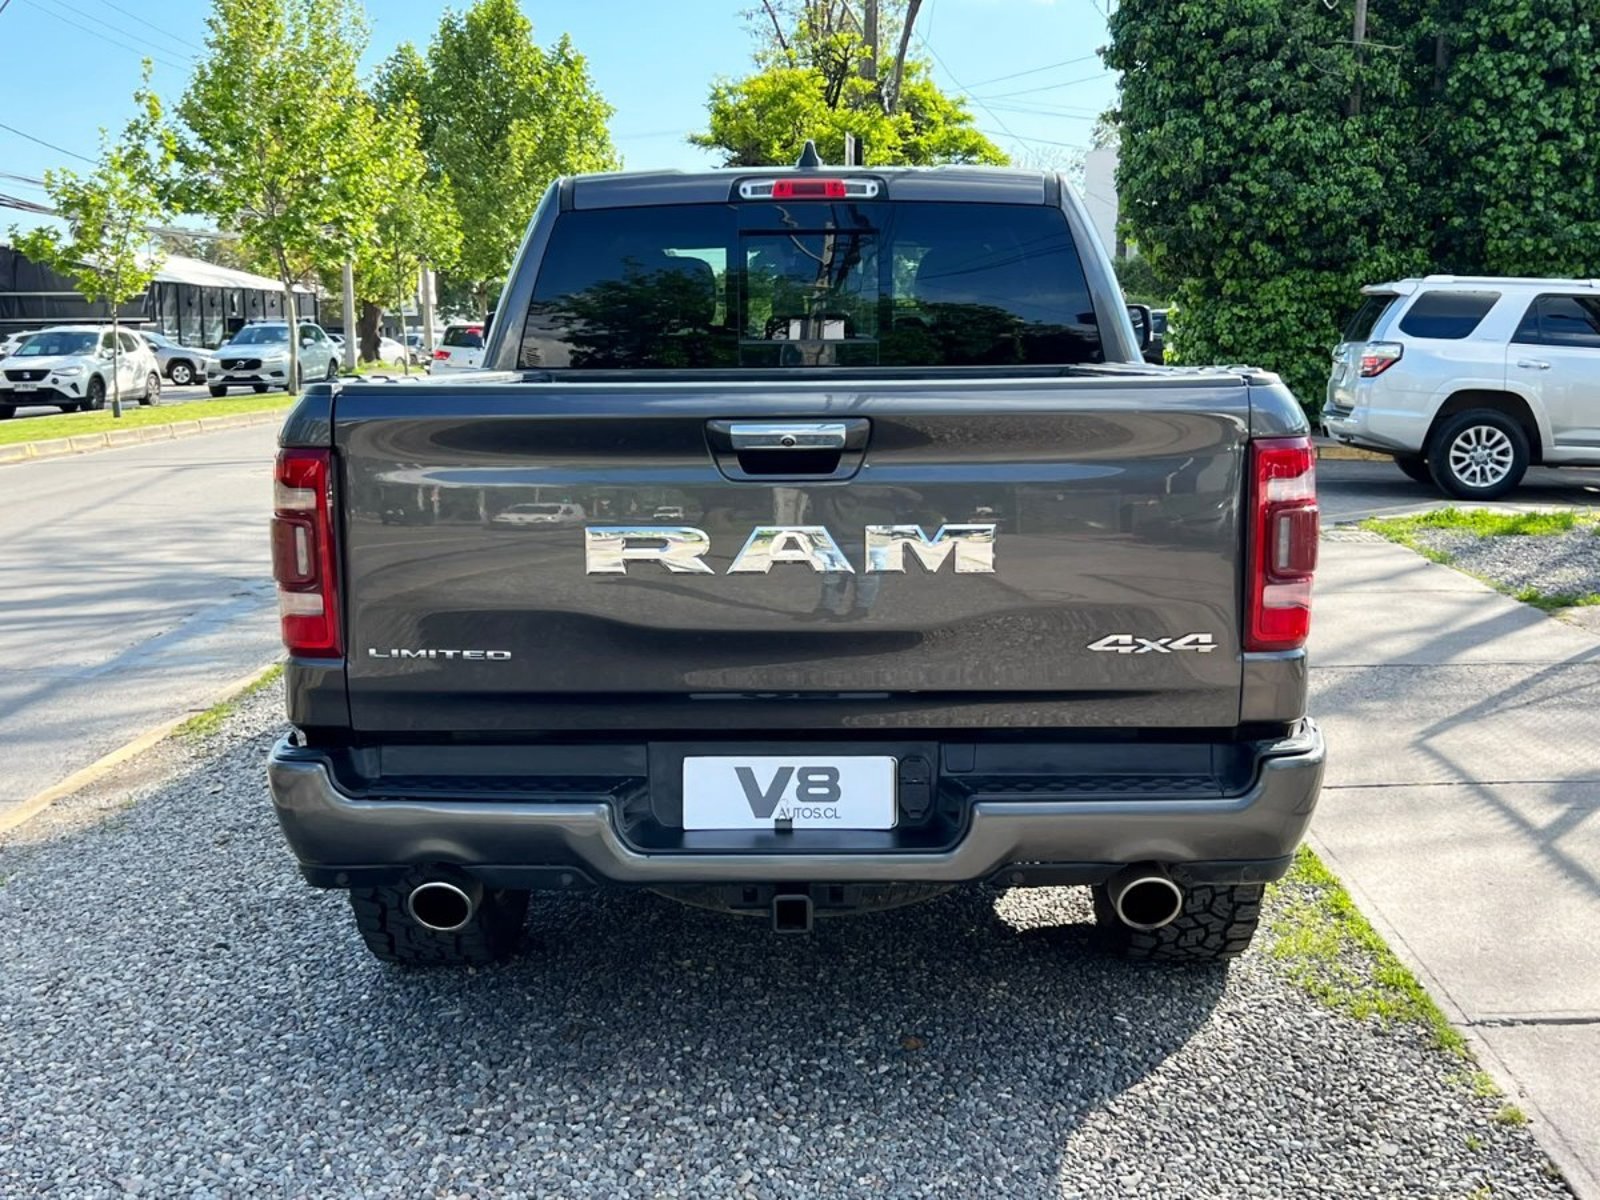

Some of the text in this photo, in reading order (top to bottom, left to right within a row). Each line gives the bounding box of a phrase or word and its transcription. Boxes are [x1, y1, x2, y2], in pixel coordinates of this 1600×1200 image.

[585, 524, 997, 575] RAM
[368, 648, 512, 661] LIMITED
[734, 766, 842, 819] V8
[778, 807, 842, 820] AUTOS.CL
